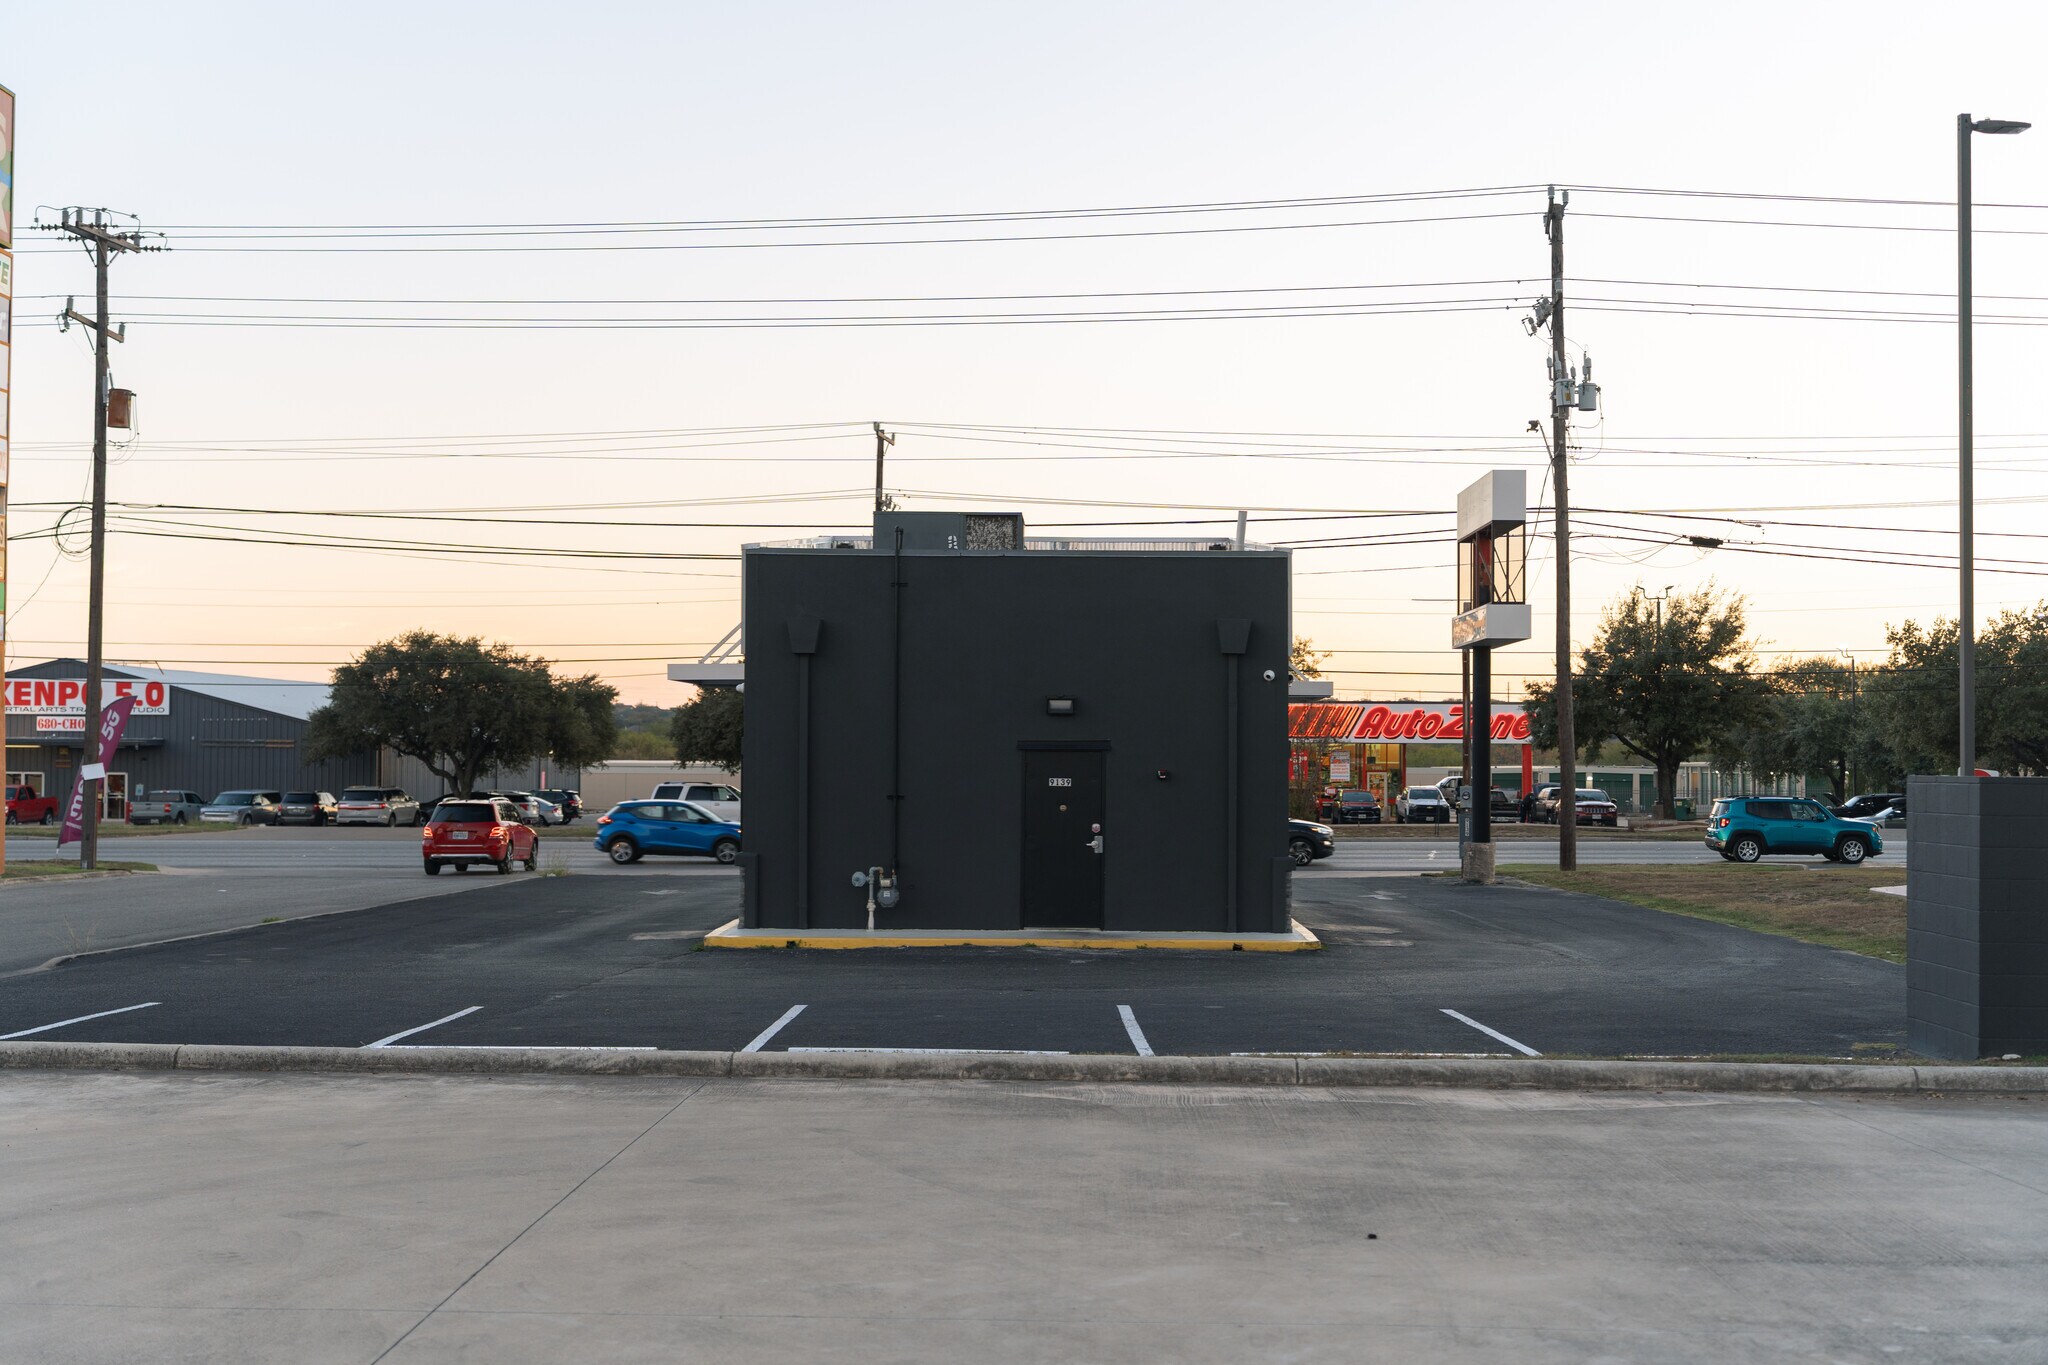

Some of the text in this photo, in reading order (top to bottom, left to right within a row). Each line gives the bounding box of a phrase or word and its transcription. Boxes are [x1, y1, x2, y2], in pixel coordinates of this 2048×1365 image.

[5, 681, 102, 707] ENP
[37, 718, 86, 730] 680-CHO
[1359, 705, 1534, 739] AutoZne
[1049, 778, 1071, 786] 9139
